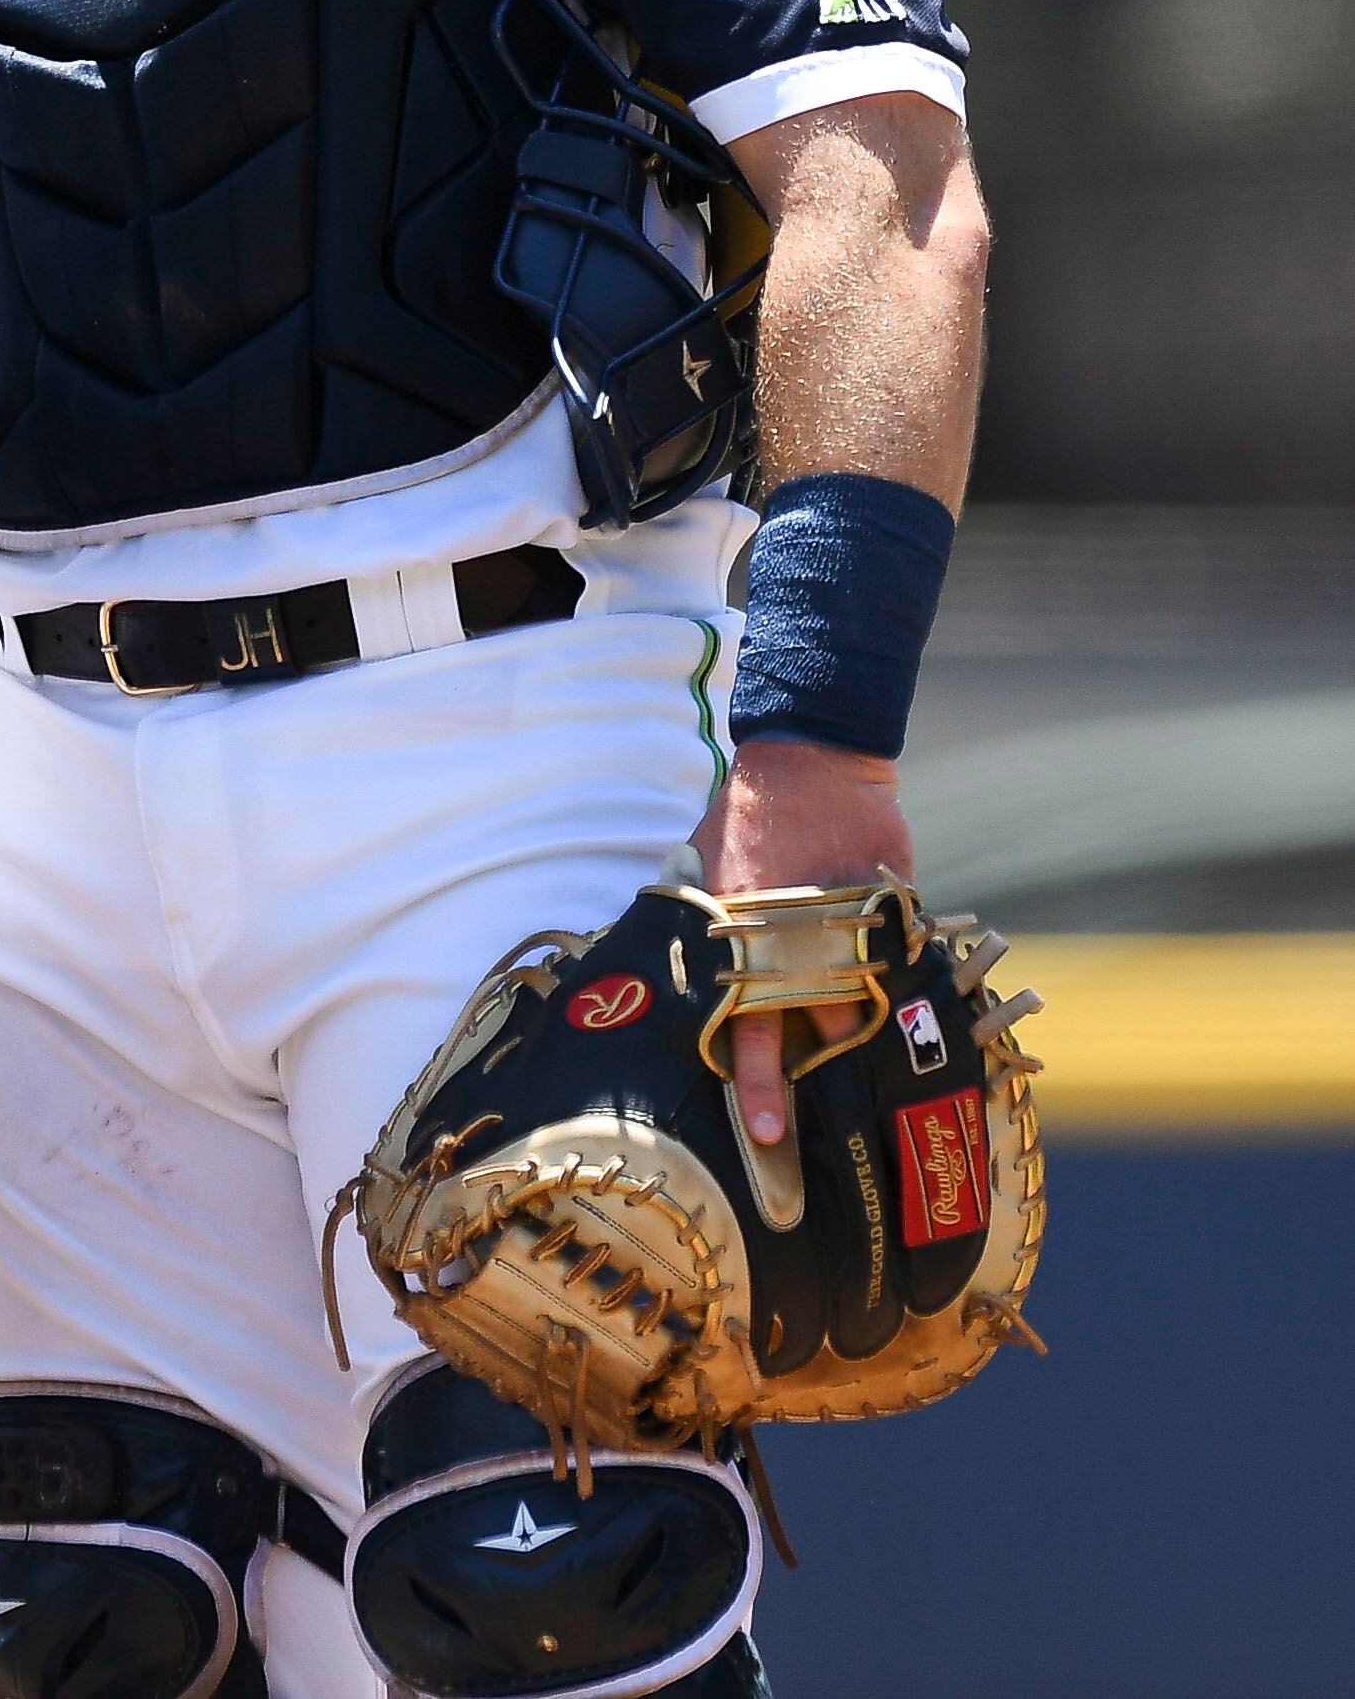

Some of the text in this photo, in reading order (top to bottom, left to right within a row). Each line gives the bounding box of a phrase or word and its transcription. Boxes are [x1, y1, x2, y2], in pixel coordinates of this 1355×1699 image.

[221, 608, 283, 671] JH
[579, 981, 646, 1028] R
[856, 1163, 881, 1222] GLOVE
[924, 1115, 964, 1226] Rawlings
[870, 1226, 883, 1274] GOLD
